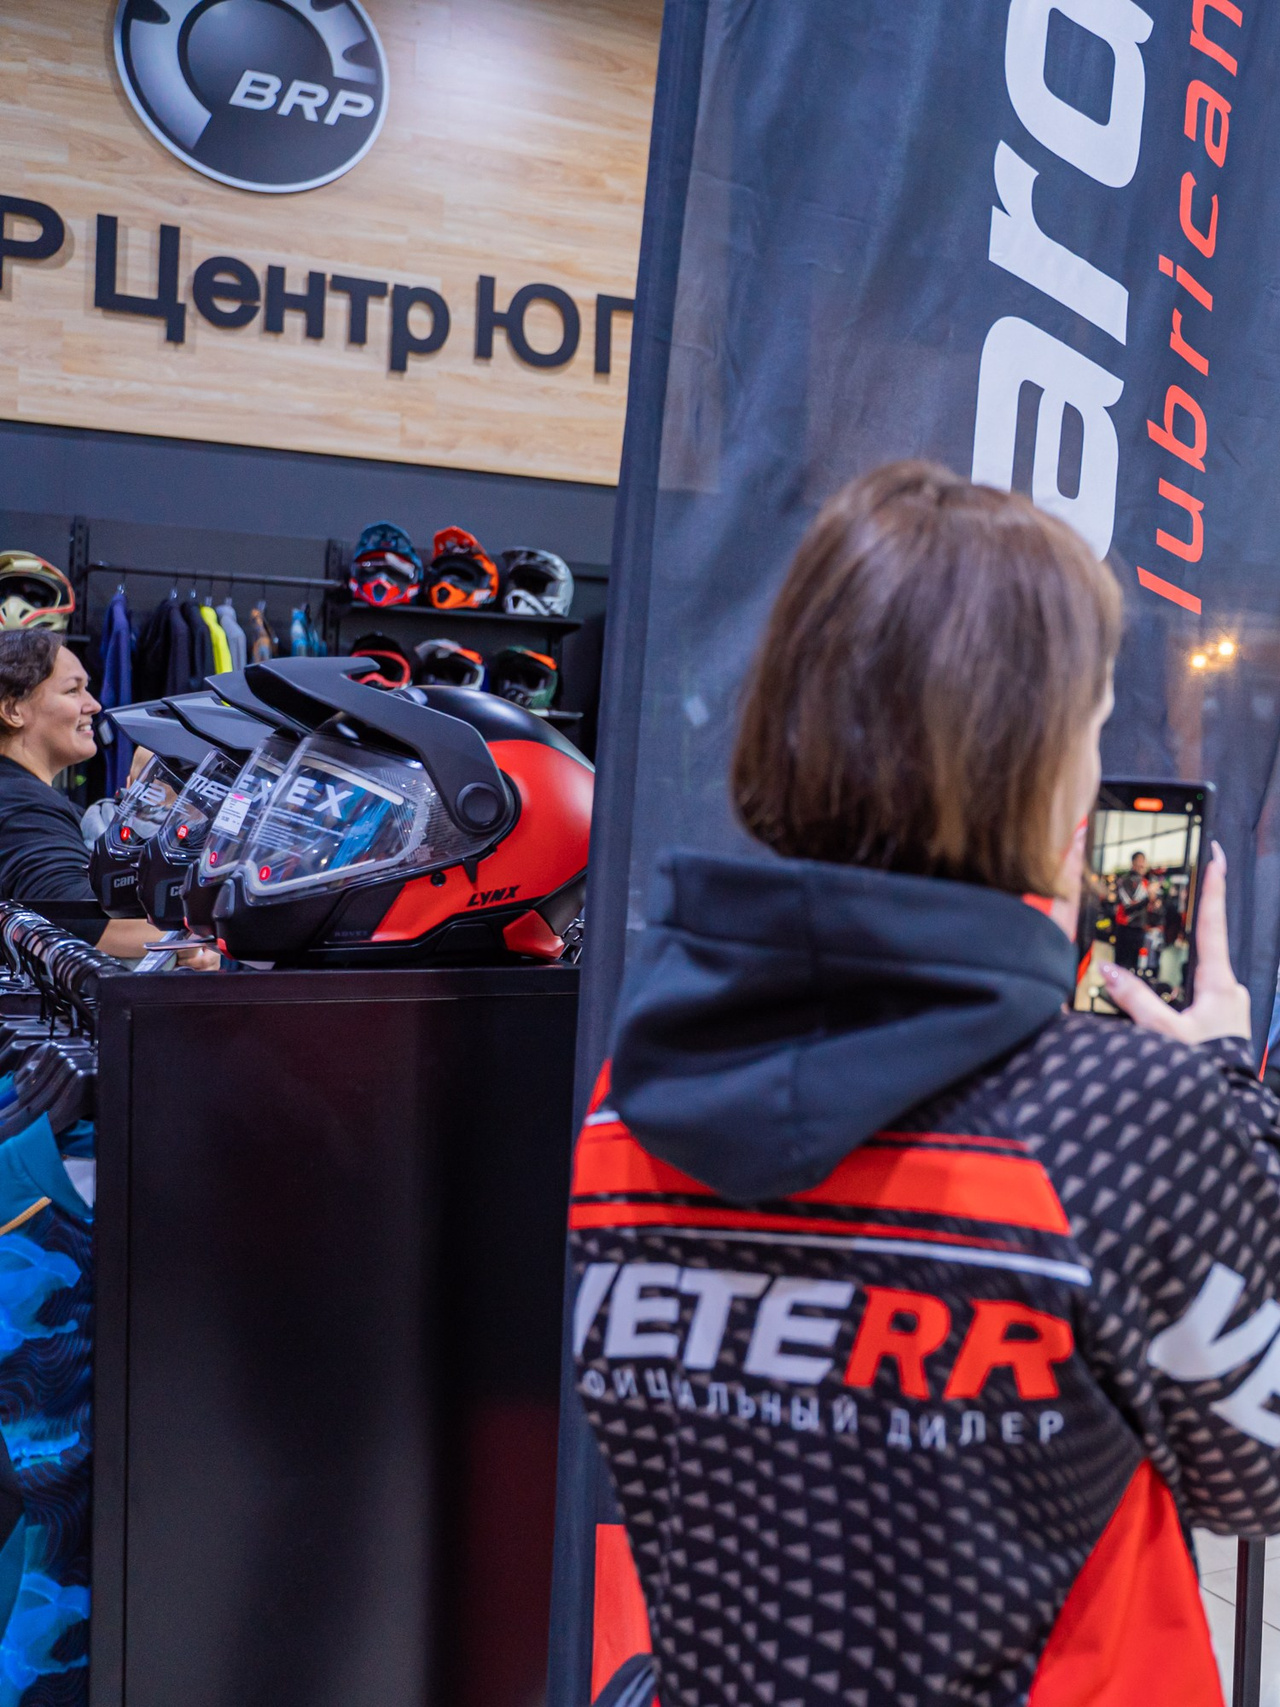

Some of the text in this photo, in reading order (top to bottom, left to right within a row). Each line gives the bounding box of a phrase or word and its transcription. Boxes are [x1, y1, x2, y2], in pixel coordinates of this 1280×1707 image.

[228, 69, 374, 126] BRP
[94, 213, 451, 372] Центр
[467, 885, 520, 907] LYNX
[887, 1408, 1064, 1451] ДИЛЕР
